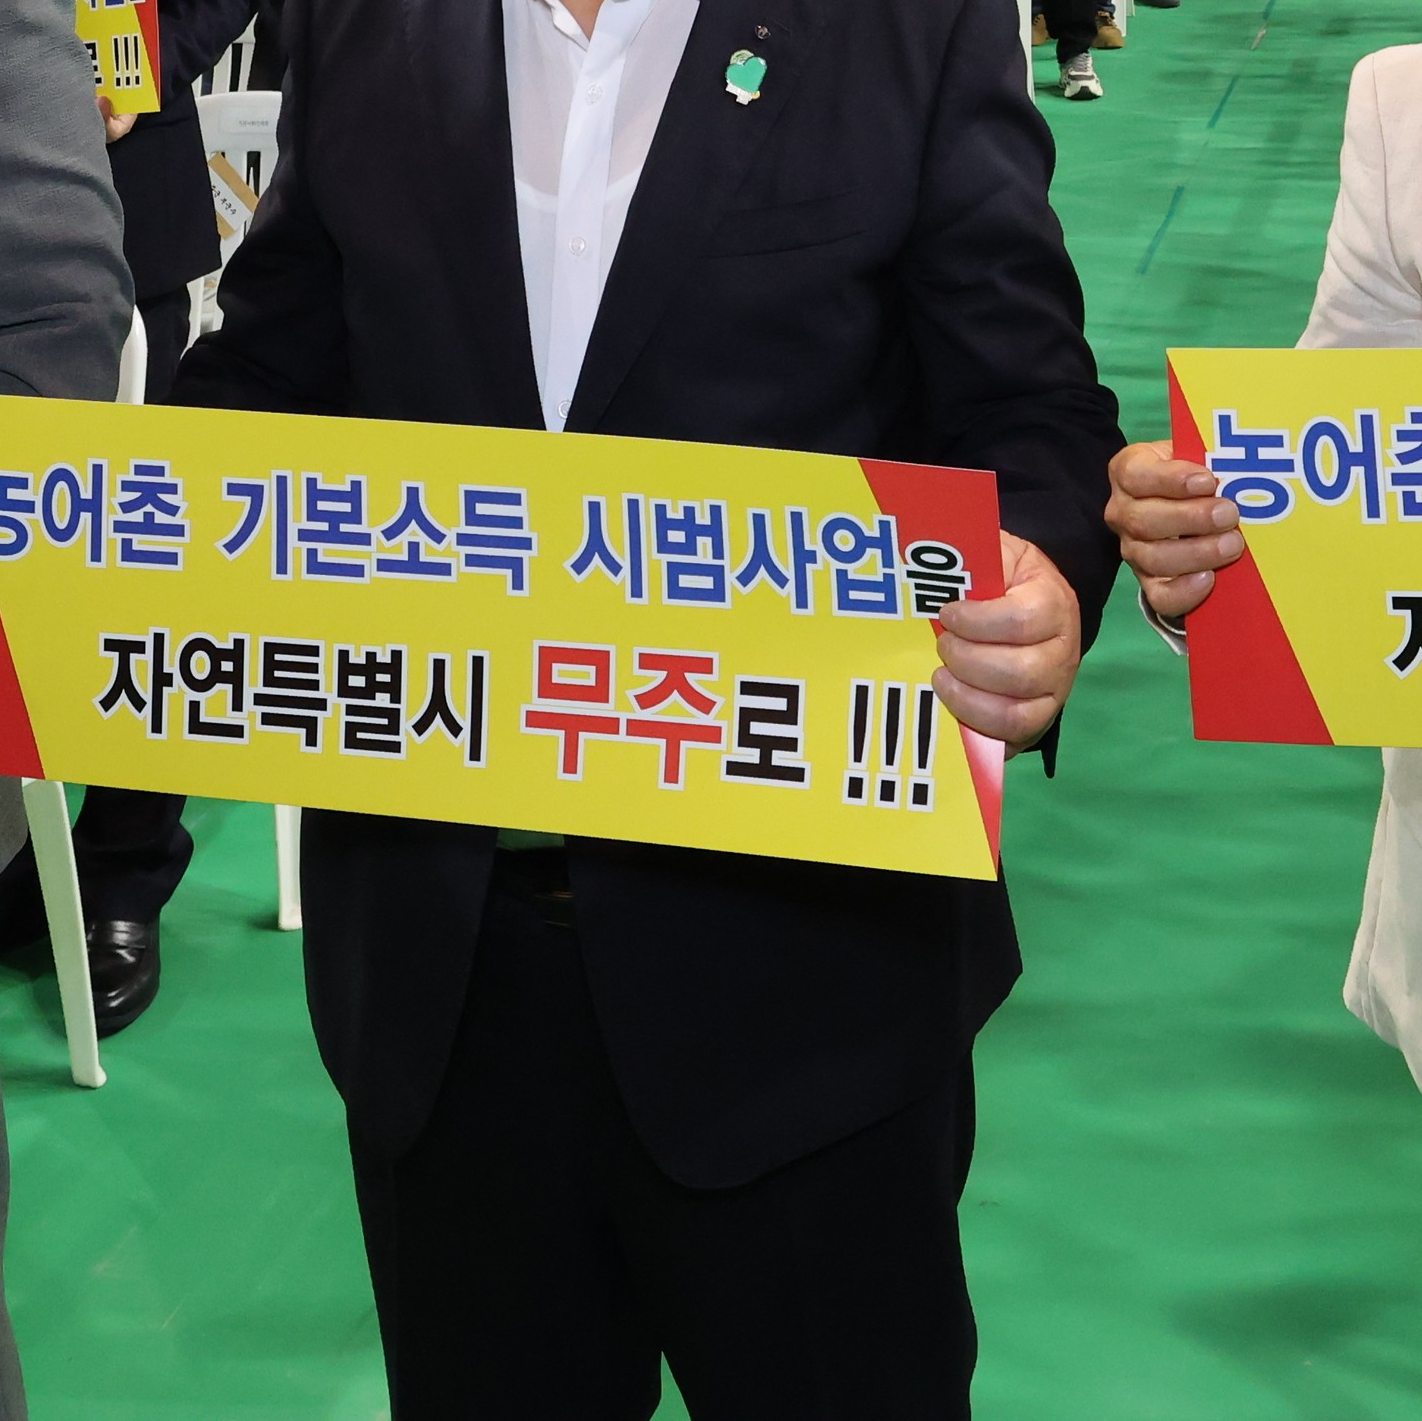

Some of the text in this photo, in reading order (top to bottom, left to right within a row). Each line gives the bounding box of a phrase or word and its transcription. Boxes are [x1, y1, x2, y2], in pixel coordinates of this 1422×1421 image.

[111, 32, 142, 89] !!!
[215, 470, 538, 597] 기본소득
[566, 492, 971, 619] 시범사업을
[97, 630, 937, 812] 자연특별시 무주로 !!!
